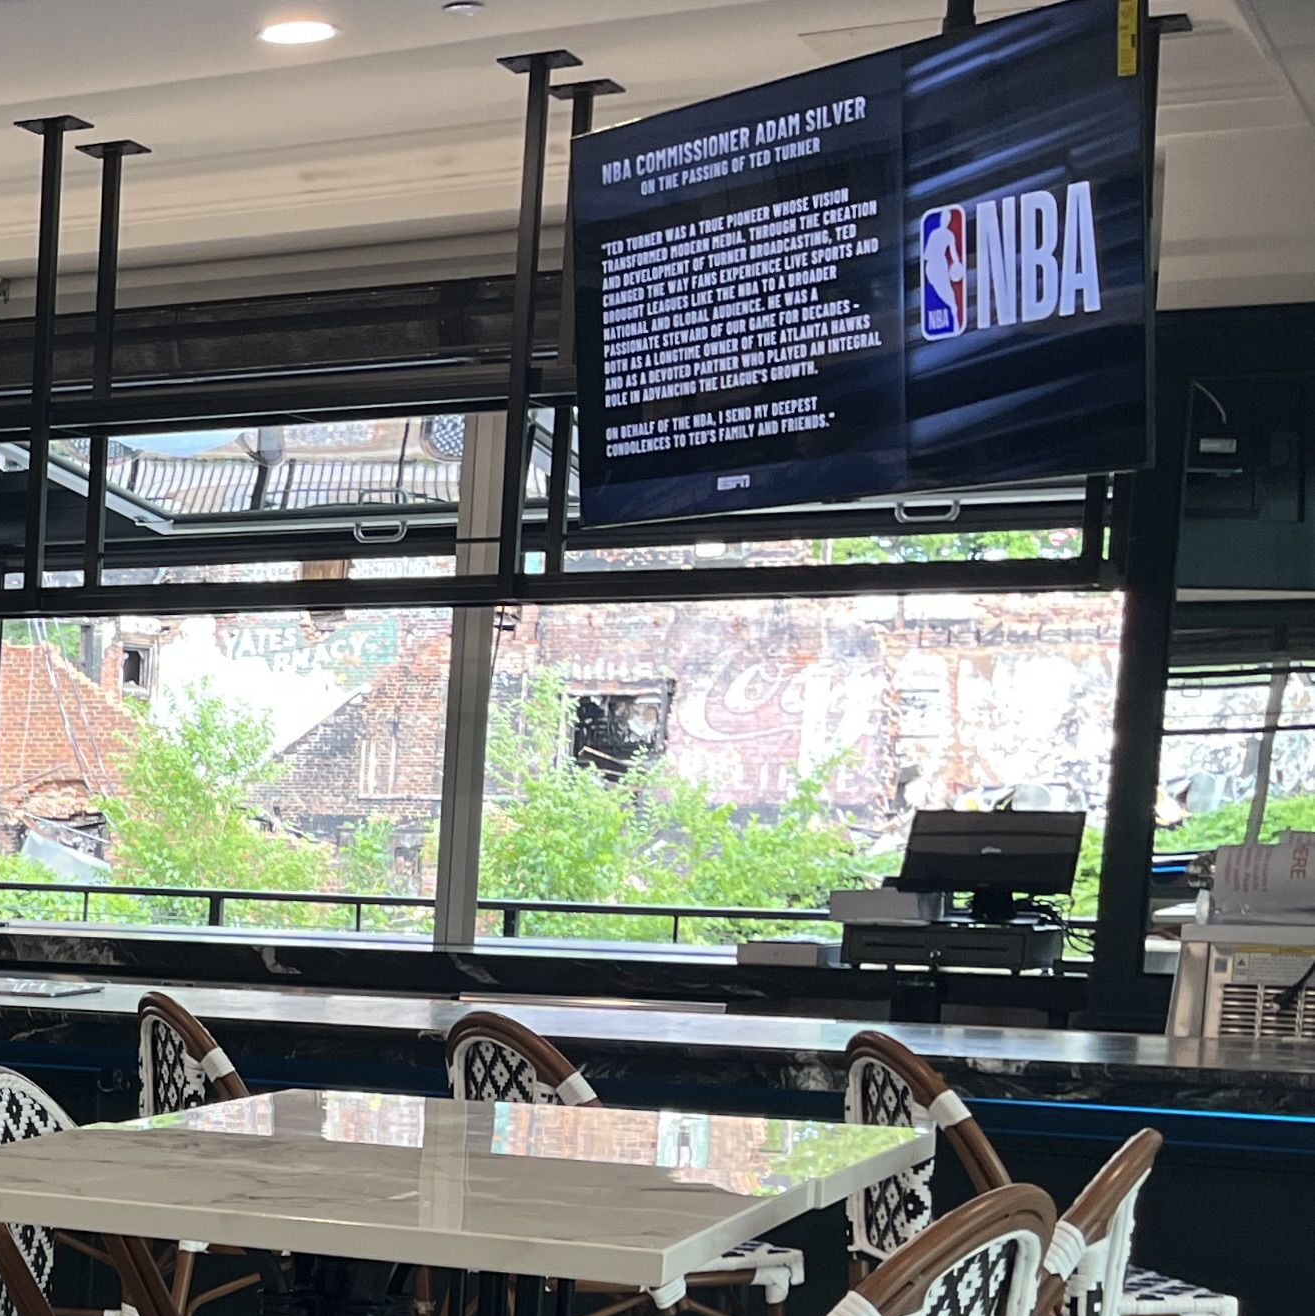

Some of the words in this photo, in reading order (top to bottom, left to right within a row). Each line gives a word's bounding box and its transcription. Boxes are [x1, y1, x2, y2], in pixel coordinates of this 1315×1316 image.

[602, 156, 631, 185] NBA
[635, 126, 749, 177] COMMISSIONER
[755, 114, 800, 146] ADAM
[805, 96, 865, 134] SILVER
[640, 178, 655, 196] ON
[658, 172, 679, 192] THE
[681, 160, 728, 186] PASSING
[731, 156, 745, 174] OF
[749, 150, 771, 170] TED
[774, 136, 820, 164] TURNER
[601, 246, 668, 274] TRANSFORMED
[669, 237, 709, 259] MODERN
[749, 218, 796, 242] THROUGH
[799, 213, 820, 232] THE
[822, 201, 877, 227] CREATION
[625, 231, 663, 251] TURNER
[664, 225, 687, 243] WAS
[689, 223, 696, 238] A
[698, 216, 724, 236] TRUE
[726, 206, 770, 229] PIONEER
[772, 197, 809, 219] WHOSE
[811, 188, 849, 211] VISION
[602, 274, 621, 291] AND
[623, 259, 689, 287] DEVELOPMENT
[692, 256, 705, 272] OF
[707, 247, 747, 269] TURNER
[835, 224, 856, 242] TED
[646, 282, 665, 299] THE
[667, 277, 689, 295] WAY
[691, 271, 717, 290] FANS
[719, 258, 782, 285] EXPERIENCE
[783, 252, 808, 272] LIVE
[810, 243, 853, 267] SPORTS
[855, 238, 879, 258] AND
[976, 181, 1101, 329] NBA
[603, 320, 649, 341] NATIONAL
[651, 316, 671, 332] AND
[672, 308, 710, 328] GLOBAL
[767, 294, 781, 311] HE
[783, 289, 808, 308] WAS
[810, 287, 818, 303] A
[646, 294, 689, 316] LEAGUES
[690, 290, 713, 308] LIKE
[715, 285, 735, 303] THE
[737, 281, 759, 298] NBA
[761, 277, 775, 294] TO
[777, 275, 785, 291] A
[787, 265, 837, 289] BROADER
[928, 309, 949, 330] NBA
[603, 335, 660, 358] PASSIONATE
[662, 326, 708, 347] STEWARD
[710, 323, 723, 339] OF
[725, 319, 746, 336] OUR
[748, 314, 776, 332] GAME
[778, 309, 799, 326] FOR
[801, 300, 850, 322] DECADES
[604, 358, 628, 375] BOTH
[630, 355, 643, 370] AS
[644, 353, 651, 368] A
[653, 344, 701, 366] LONGTIME
[703, 338, 738, 357] OWNER
[740, 335, 754, 351] OF
[757, 331, 777, 348] THE
[779, 322, 828, 344] ATLANTA
[830, 314, 870, 335] HAWKS
[604, 375, 623, 391] AND
[625, 373, 637, 388] AS
[639, 371, 646, 386] A
[648, 364, 691, 384] DEVOTED
[693, 356, 739, 377] PARTNER
[741, 352, 765, 369] WHO
[766, 344, 807, 365] PLAYED
[809, 342, 825, 358] AN
[827, 332, 882, 355] INTEGRAL
[604, 392, 628, 408] ROLE
[629, 390, 640, 404] IN
[642, 380, 696, 402] ADVANCING
[698, 377, 718, 394] THE
[605, 426, 618, 441] ON
[620, 421, 655, 439] BEHALF
[657, 418, 669, 434] OF
[672, 415, 691, 432] THE
[718, 411, 723, 425] I
[725, 406, 751, 424] SEND
[753, 404, 768, 420] MY
[771, 397, 817, 418] DEEPEST
[606, 436, 671, 458] CONDOLENCES
[673, 433, 686, 449] TO
[718, 423, 755, 442] FAMILY
[757, 420, 779, 437] AND
[221, 627, 297, 659] YATES
[273, 633, 369, 672] RMACY
